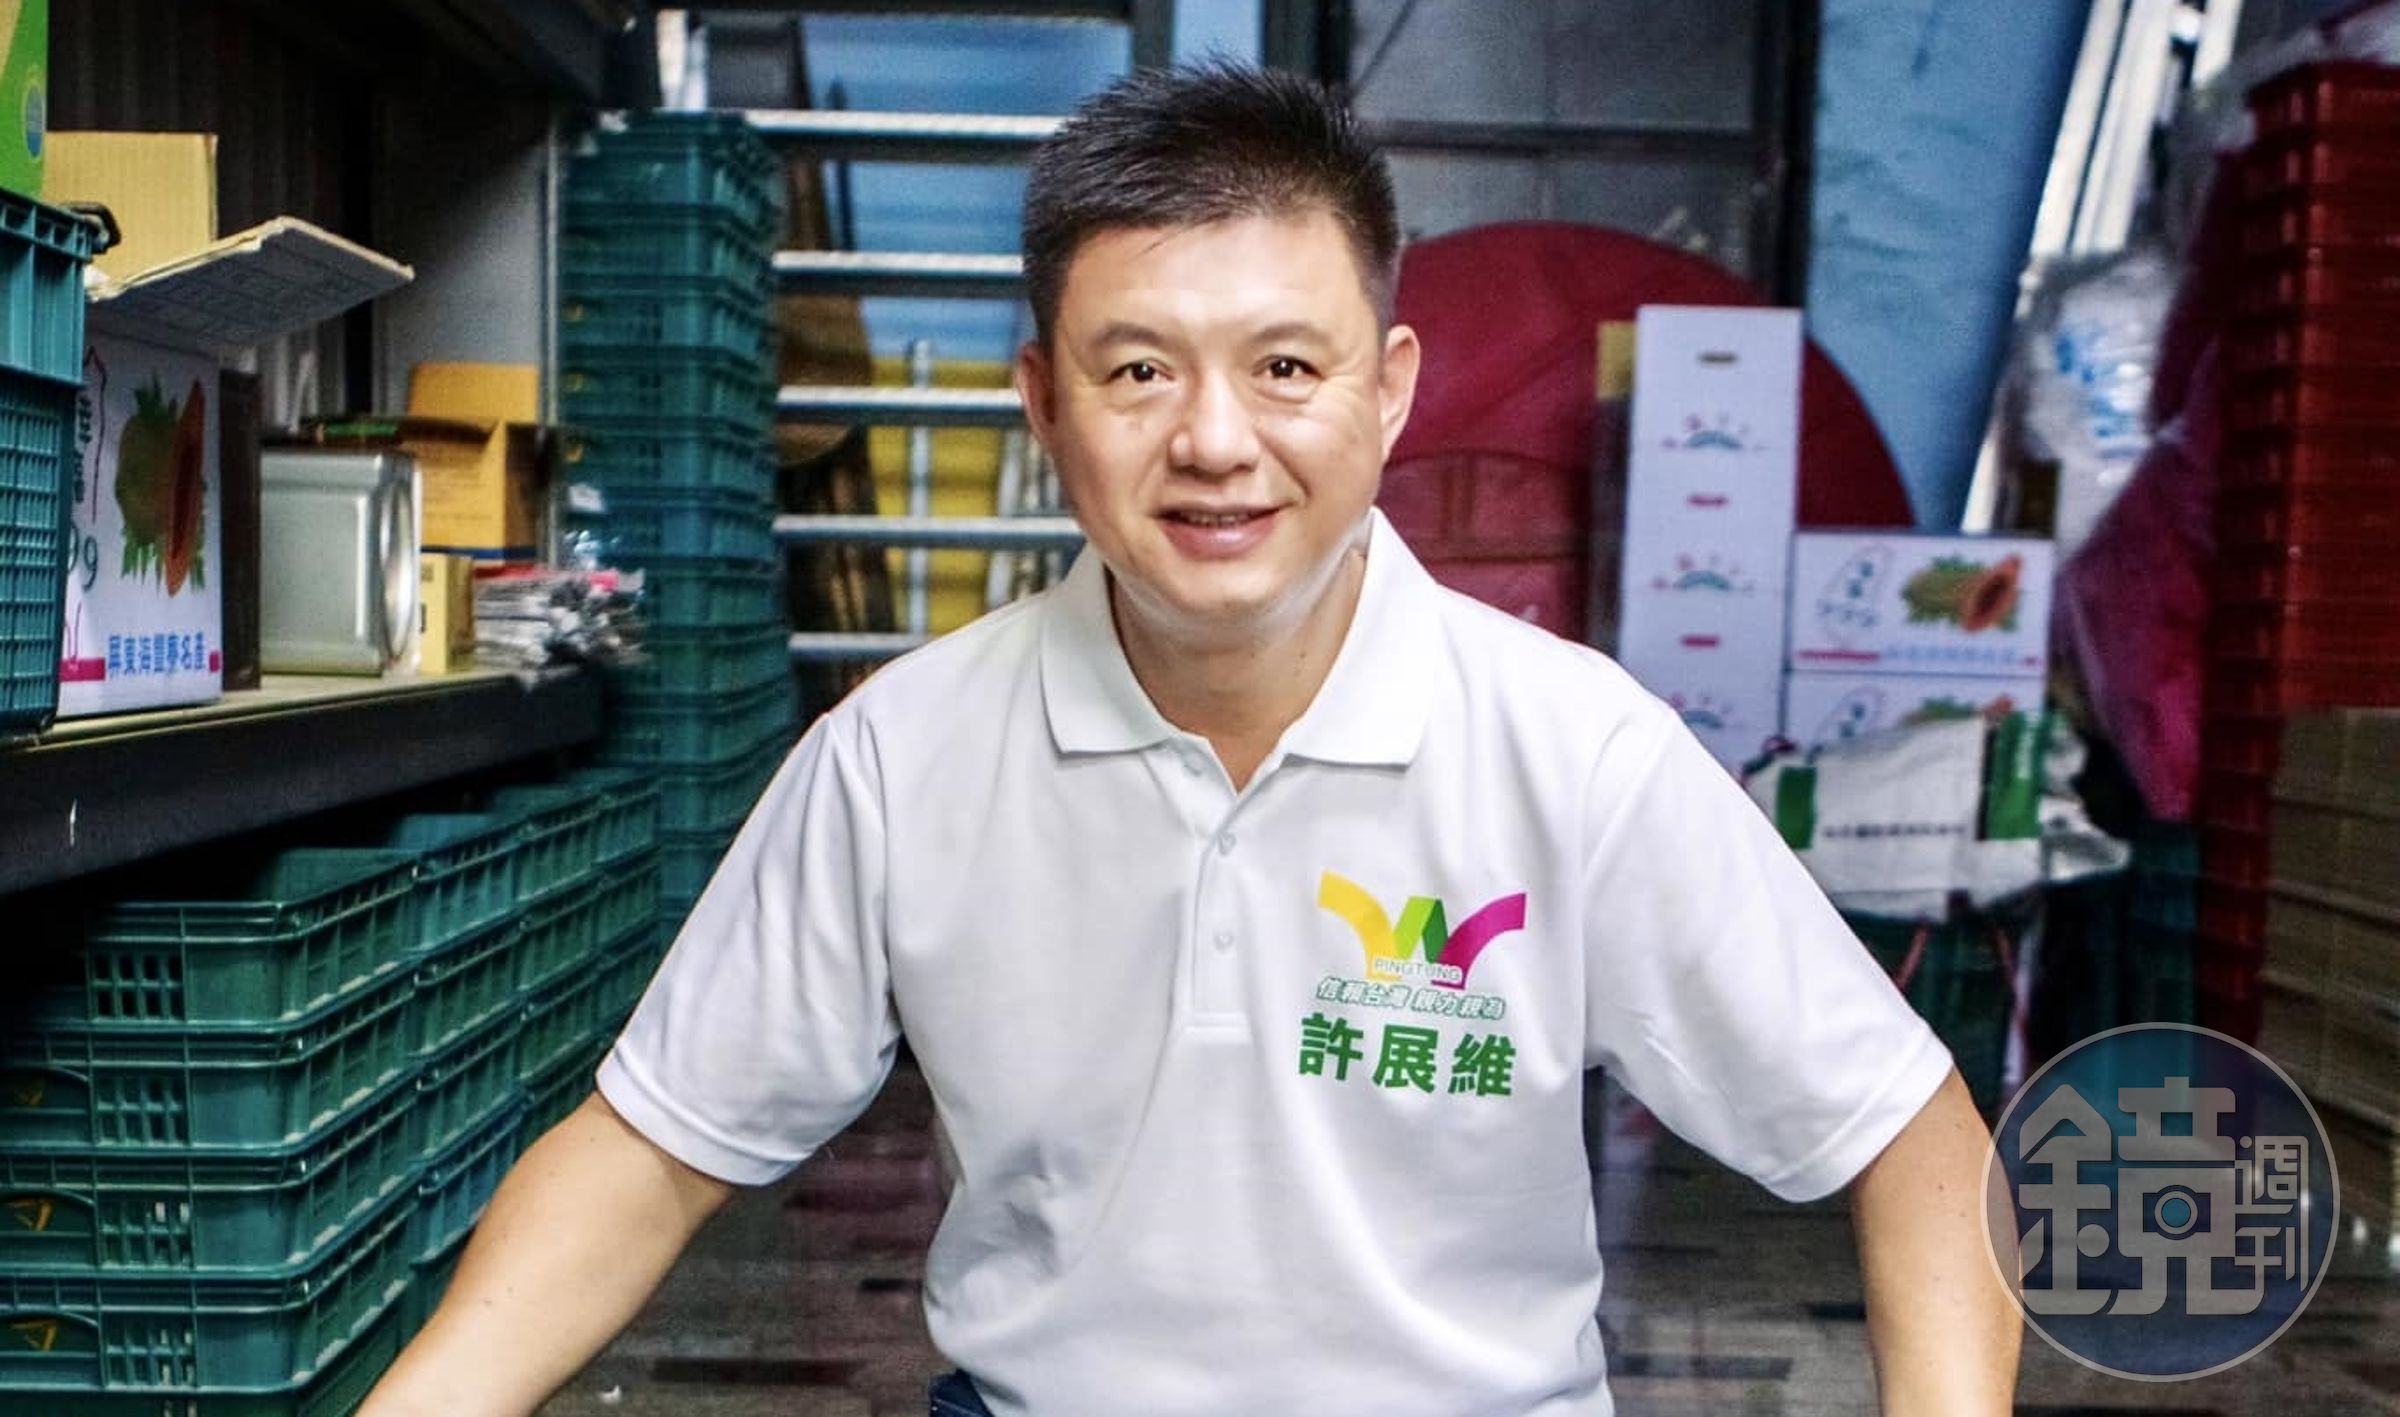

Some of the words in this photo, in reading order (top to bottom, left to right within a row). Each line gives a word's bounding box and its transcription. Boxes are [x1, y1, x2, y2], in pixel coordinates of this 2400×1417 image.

[1374, 958, 1461, 981] PINGTUNG
[1298, 1012, 1517, 1097] 許展維
